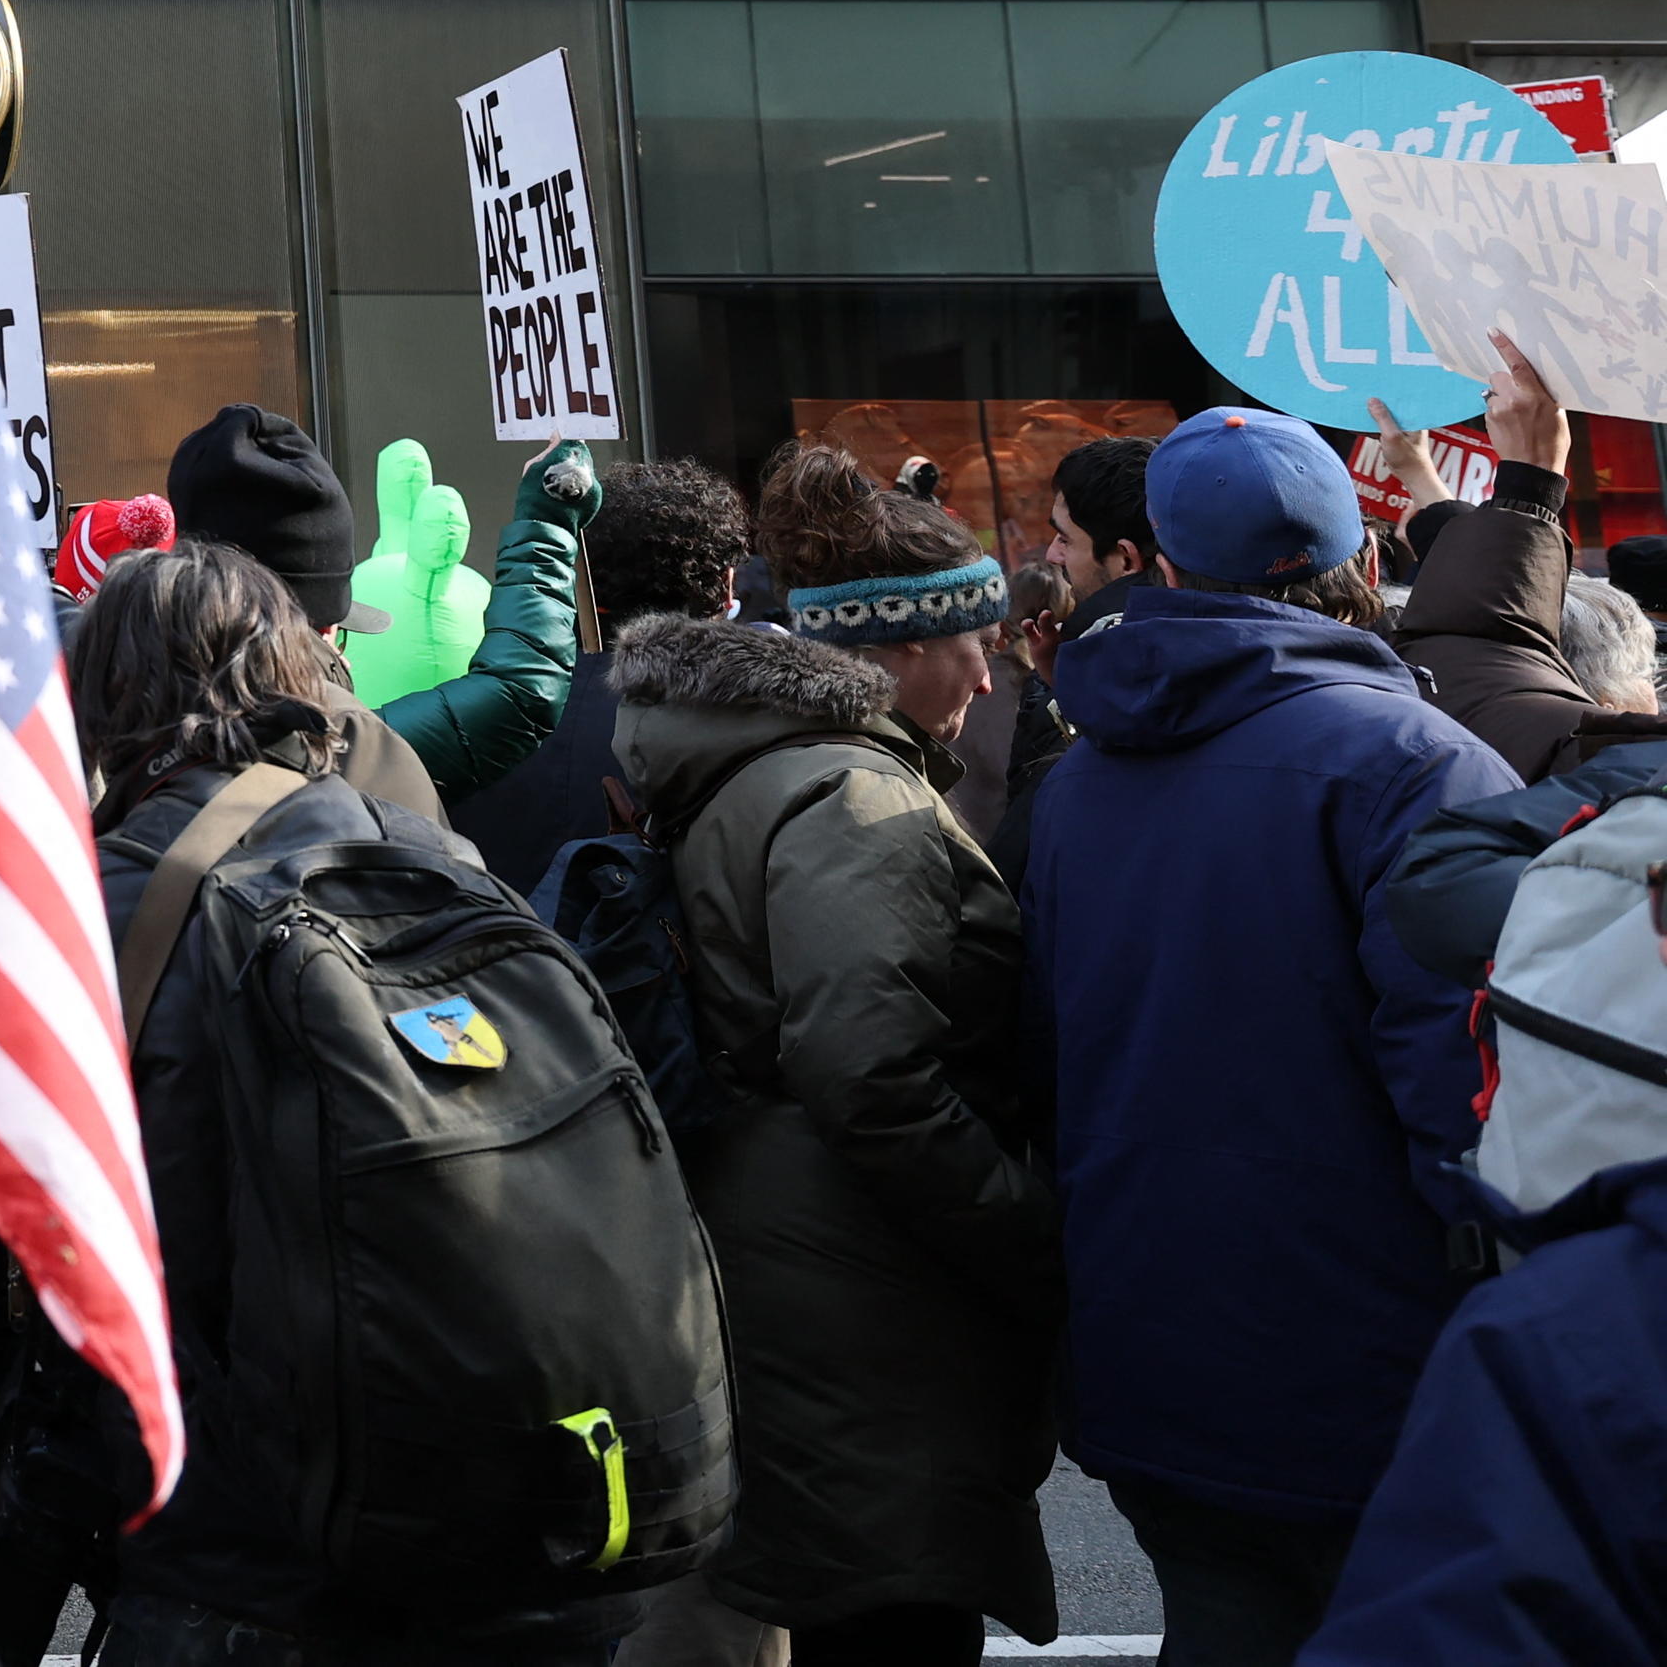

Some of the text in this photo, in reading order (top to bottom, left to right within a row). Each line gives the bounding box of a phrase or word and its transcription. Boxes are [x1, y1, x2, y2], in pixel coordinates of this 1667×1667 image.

[466, 89, 511, 190] WE
[1518, 86, 1585, 106] ANDING
[483, 168, 587, 296] ARE THE
[488, 290, 610, 424] PEOPLE
[1245, 271, 1443, 392] ALL
